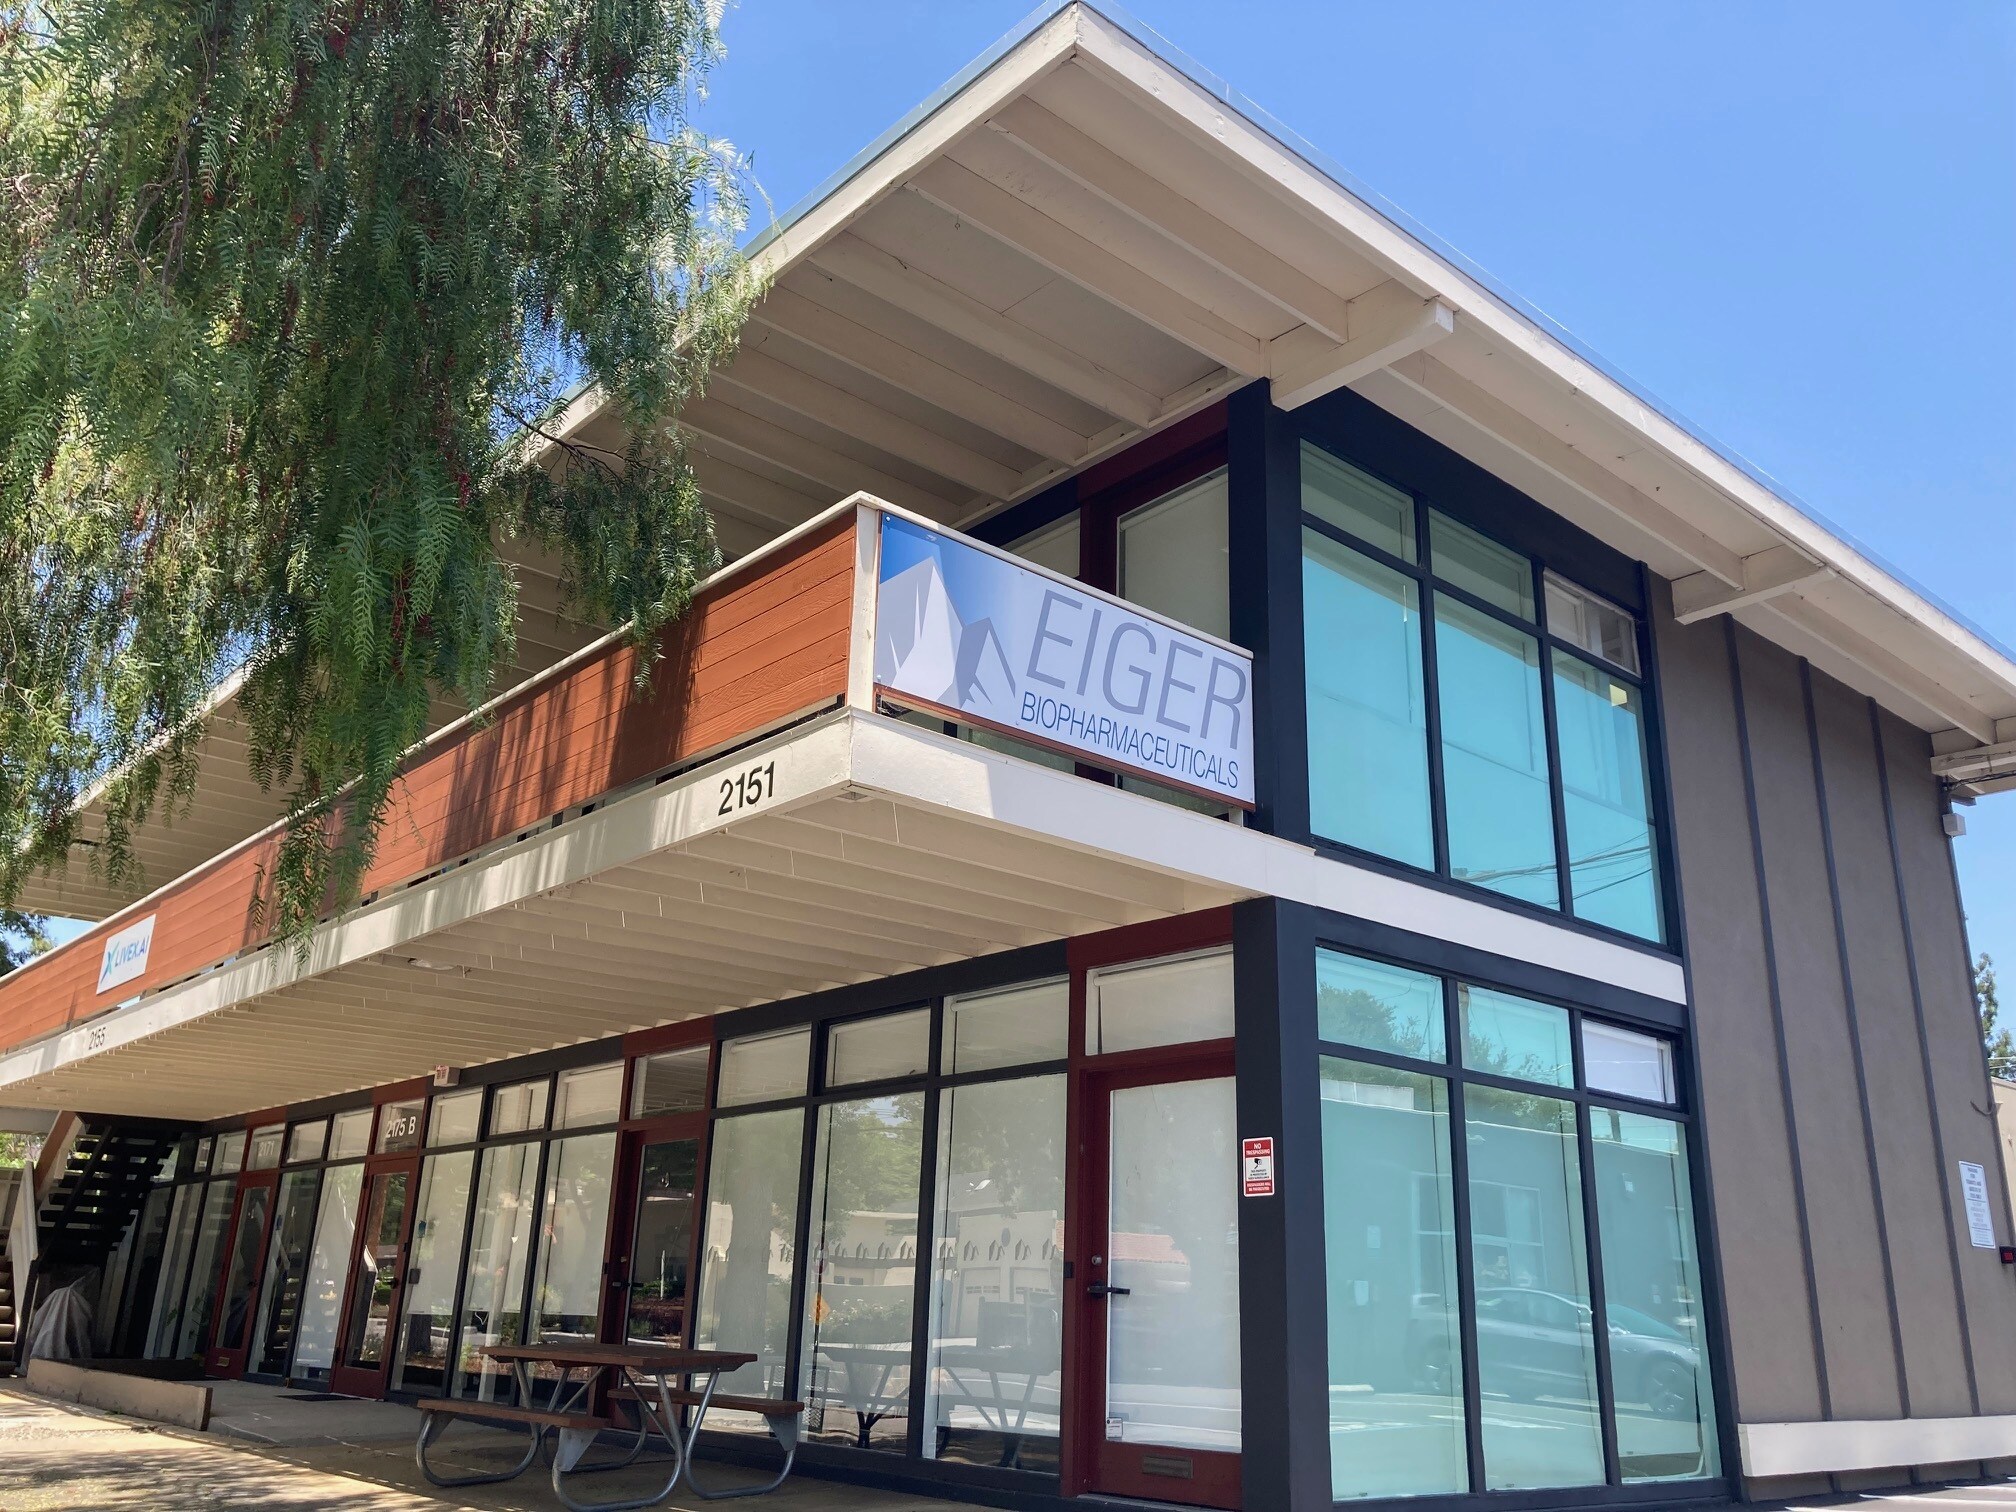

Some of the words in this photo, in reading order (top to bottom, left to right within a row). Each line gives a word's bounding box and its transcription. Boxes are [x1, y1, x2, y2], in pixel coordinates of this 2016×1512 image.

[1026, 588, 1247, 750] EIGER
[1021, 691, 1239, 789] BIOPHARMACEUTICALS
[718, 760, 775, 816] 2151
[88, 1026, 106, 1051] 2155
[385, 1117, 407, 1139] 2175
[408, 1116, 417, 1135] B
